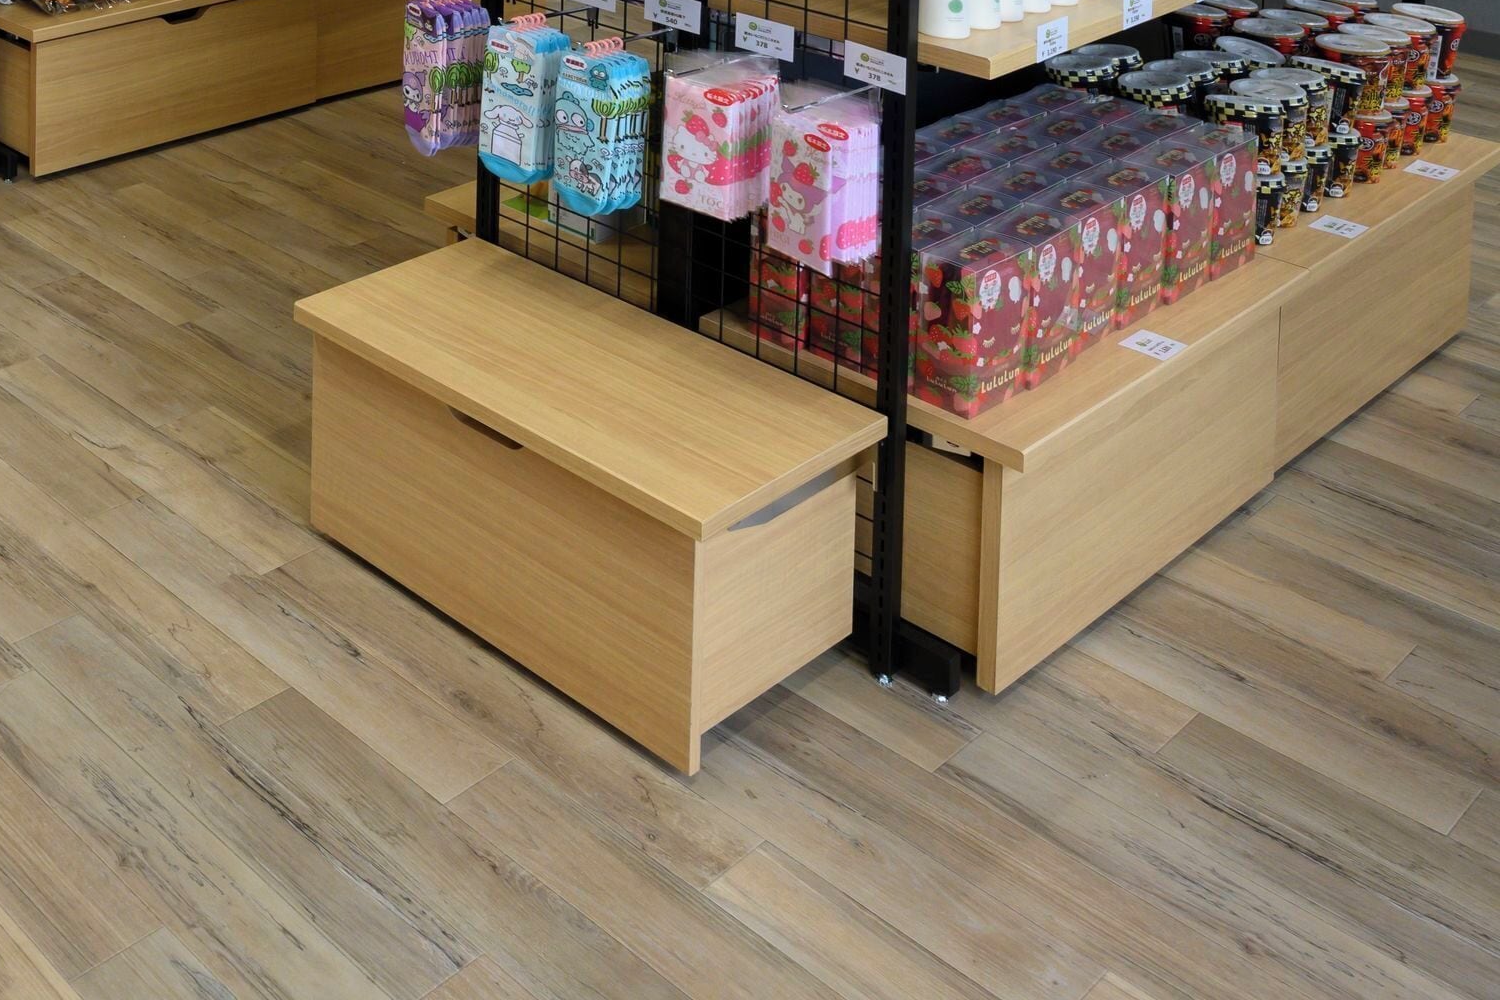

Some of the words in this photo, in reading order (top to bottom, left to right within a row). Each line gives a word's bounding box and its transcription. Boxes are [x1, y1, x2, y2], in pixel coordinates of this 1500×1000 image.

[756, 40, 768, 48] 378
[405, 50, 438, 65] KUROMI
[868, 72, 881, 81] 378
[1041, 337, 1073, 364] LuLuLun
[981, 367, 1020, 393] LuLuLun
